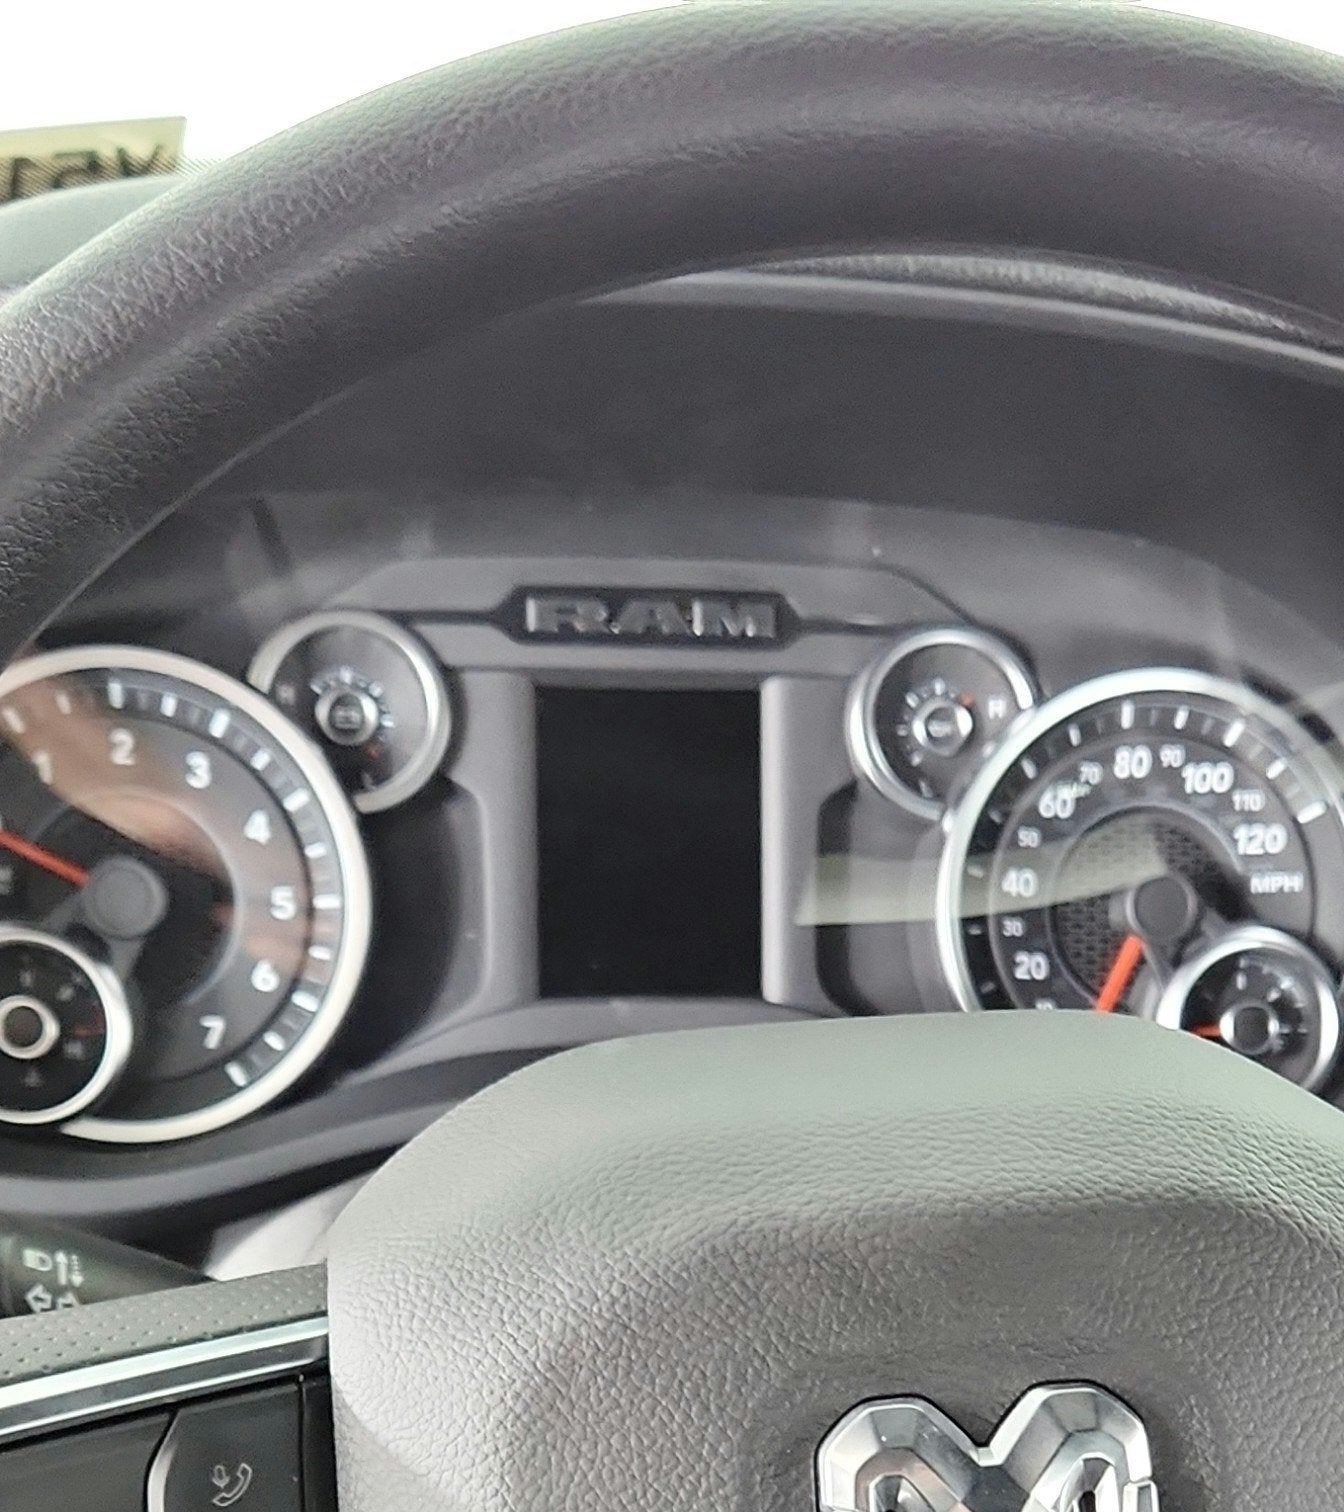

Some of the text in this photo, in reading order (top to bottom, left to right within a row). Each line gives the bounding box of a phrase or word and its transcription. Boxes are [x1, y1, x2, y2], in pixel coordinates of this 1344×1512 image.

[524, 597, 776, 639] RAM
[110, 729, 135, 766] 2
[1113, 745, 1153, 780] 80
[1159, 744, 1186, 768] 90
[32, 750, 53, 786] 1
[186, 751, 211, 789] 3
[1079, 760, 1105, 784] 70
[1182, 761, 1235, 795] 100
[1038, 784, 1077, 819] 60
[1233, 790, 1265, 813] 110
[244, 811, 271, 845] 4
[1017, 827, 1041, 848] 50
[1233, 823, 1287, 855] 120
[1001, 869, 1038, 898] 40
[1250, 871, 1304, 893] MPH
[270, 886, 297, 921] 5
[1002, 917, 1024, 937] 30
[251, 959, 279, 992] 6
[1014, 951, 1049, 981] 20
[201, 1015, 226, 1049] 7
